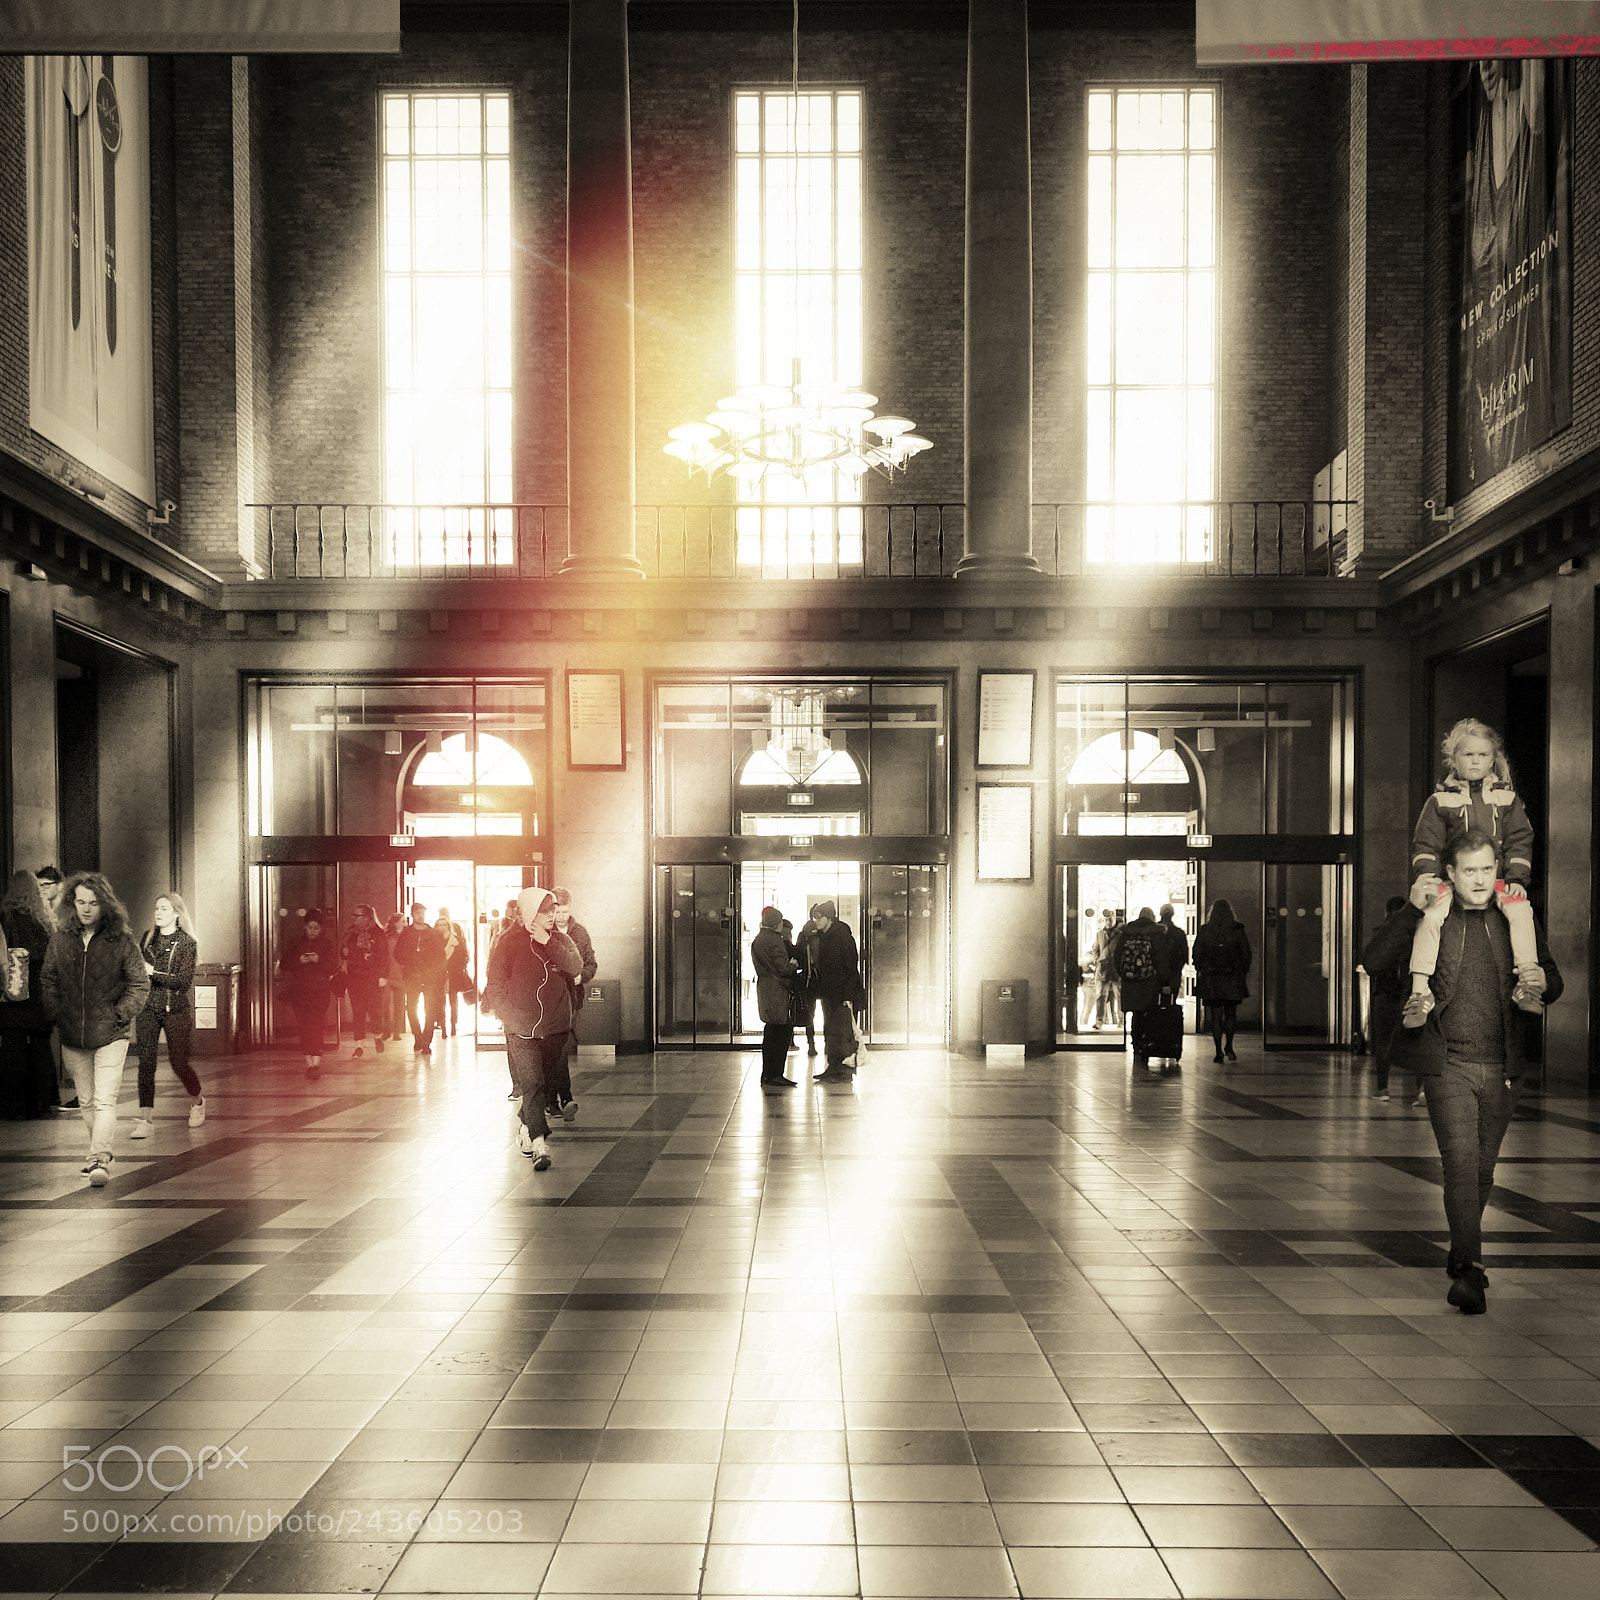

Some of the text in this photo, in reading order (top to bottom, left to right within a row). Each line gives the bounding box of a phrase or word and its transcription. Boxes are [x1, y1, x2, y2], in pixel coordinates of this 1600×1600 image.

[1461, 230, 1559, 331] NEW COLLECTION
[1480, 357, 1534, 421] PILGRIM
